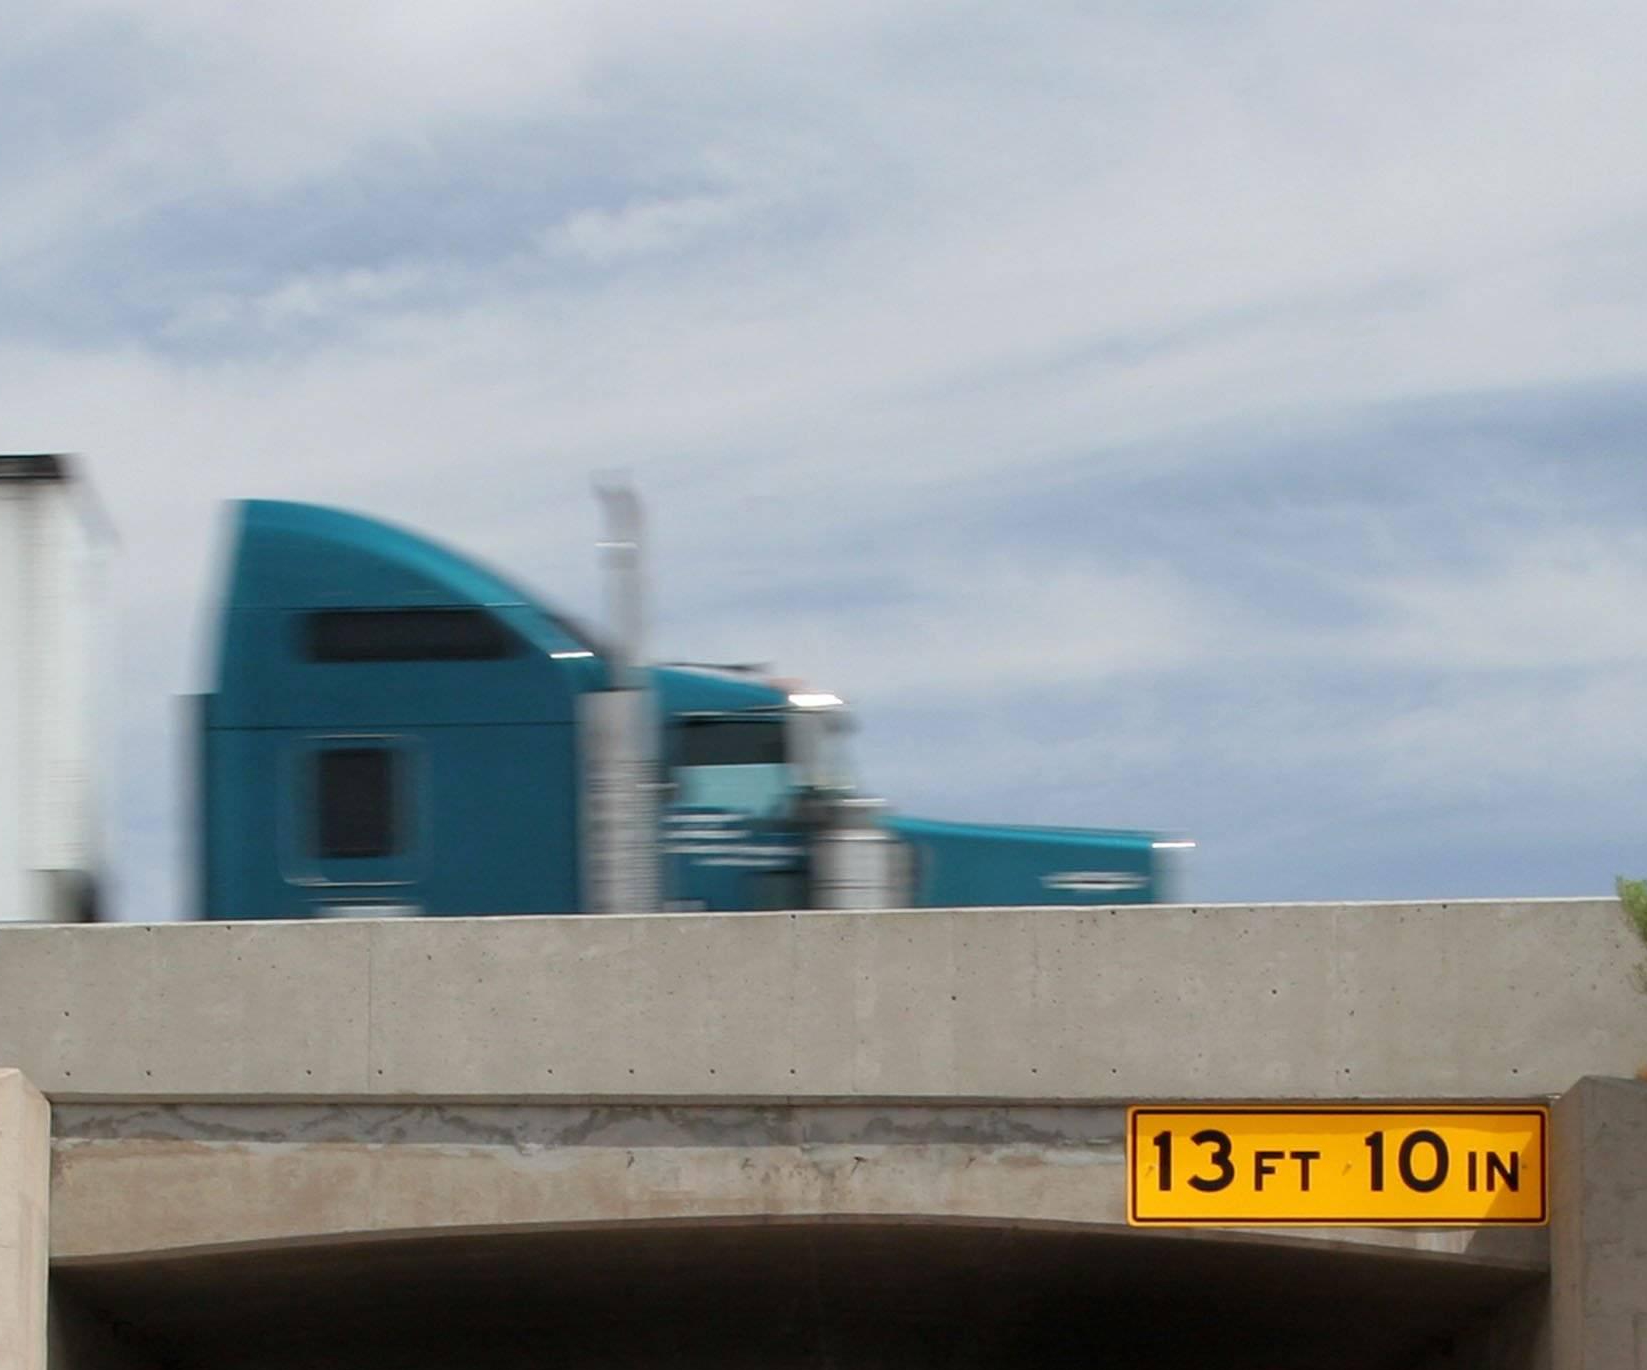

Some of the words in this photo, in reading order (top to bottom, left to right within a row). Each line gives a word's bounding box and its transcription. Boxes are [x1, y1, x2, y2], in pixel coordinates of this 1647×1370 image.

[1153, 1129, 1235, 1193] 13
[1254, 1151, 1321, 1192] FT
[1364, 1129, 1449, 1193] 10
[1467, 1151, 1519, 1193] IN
